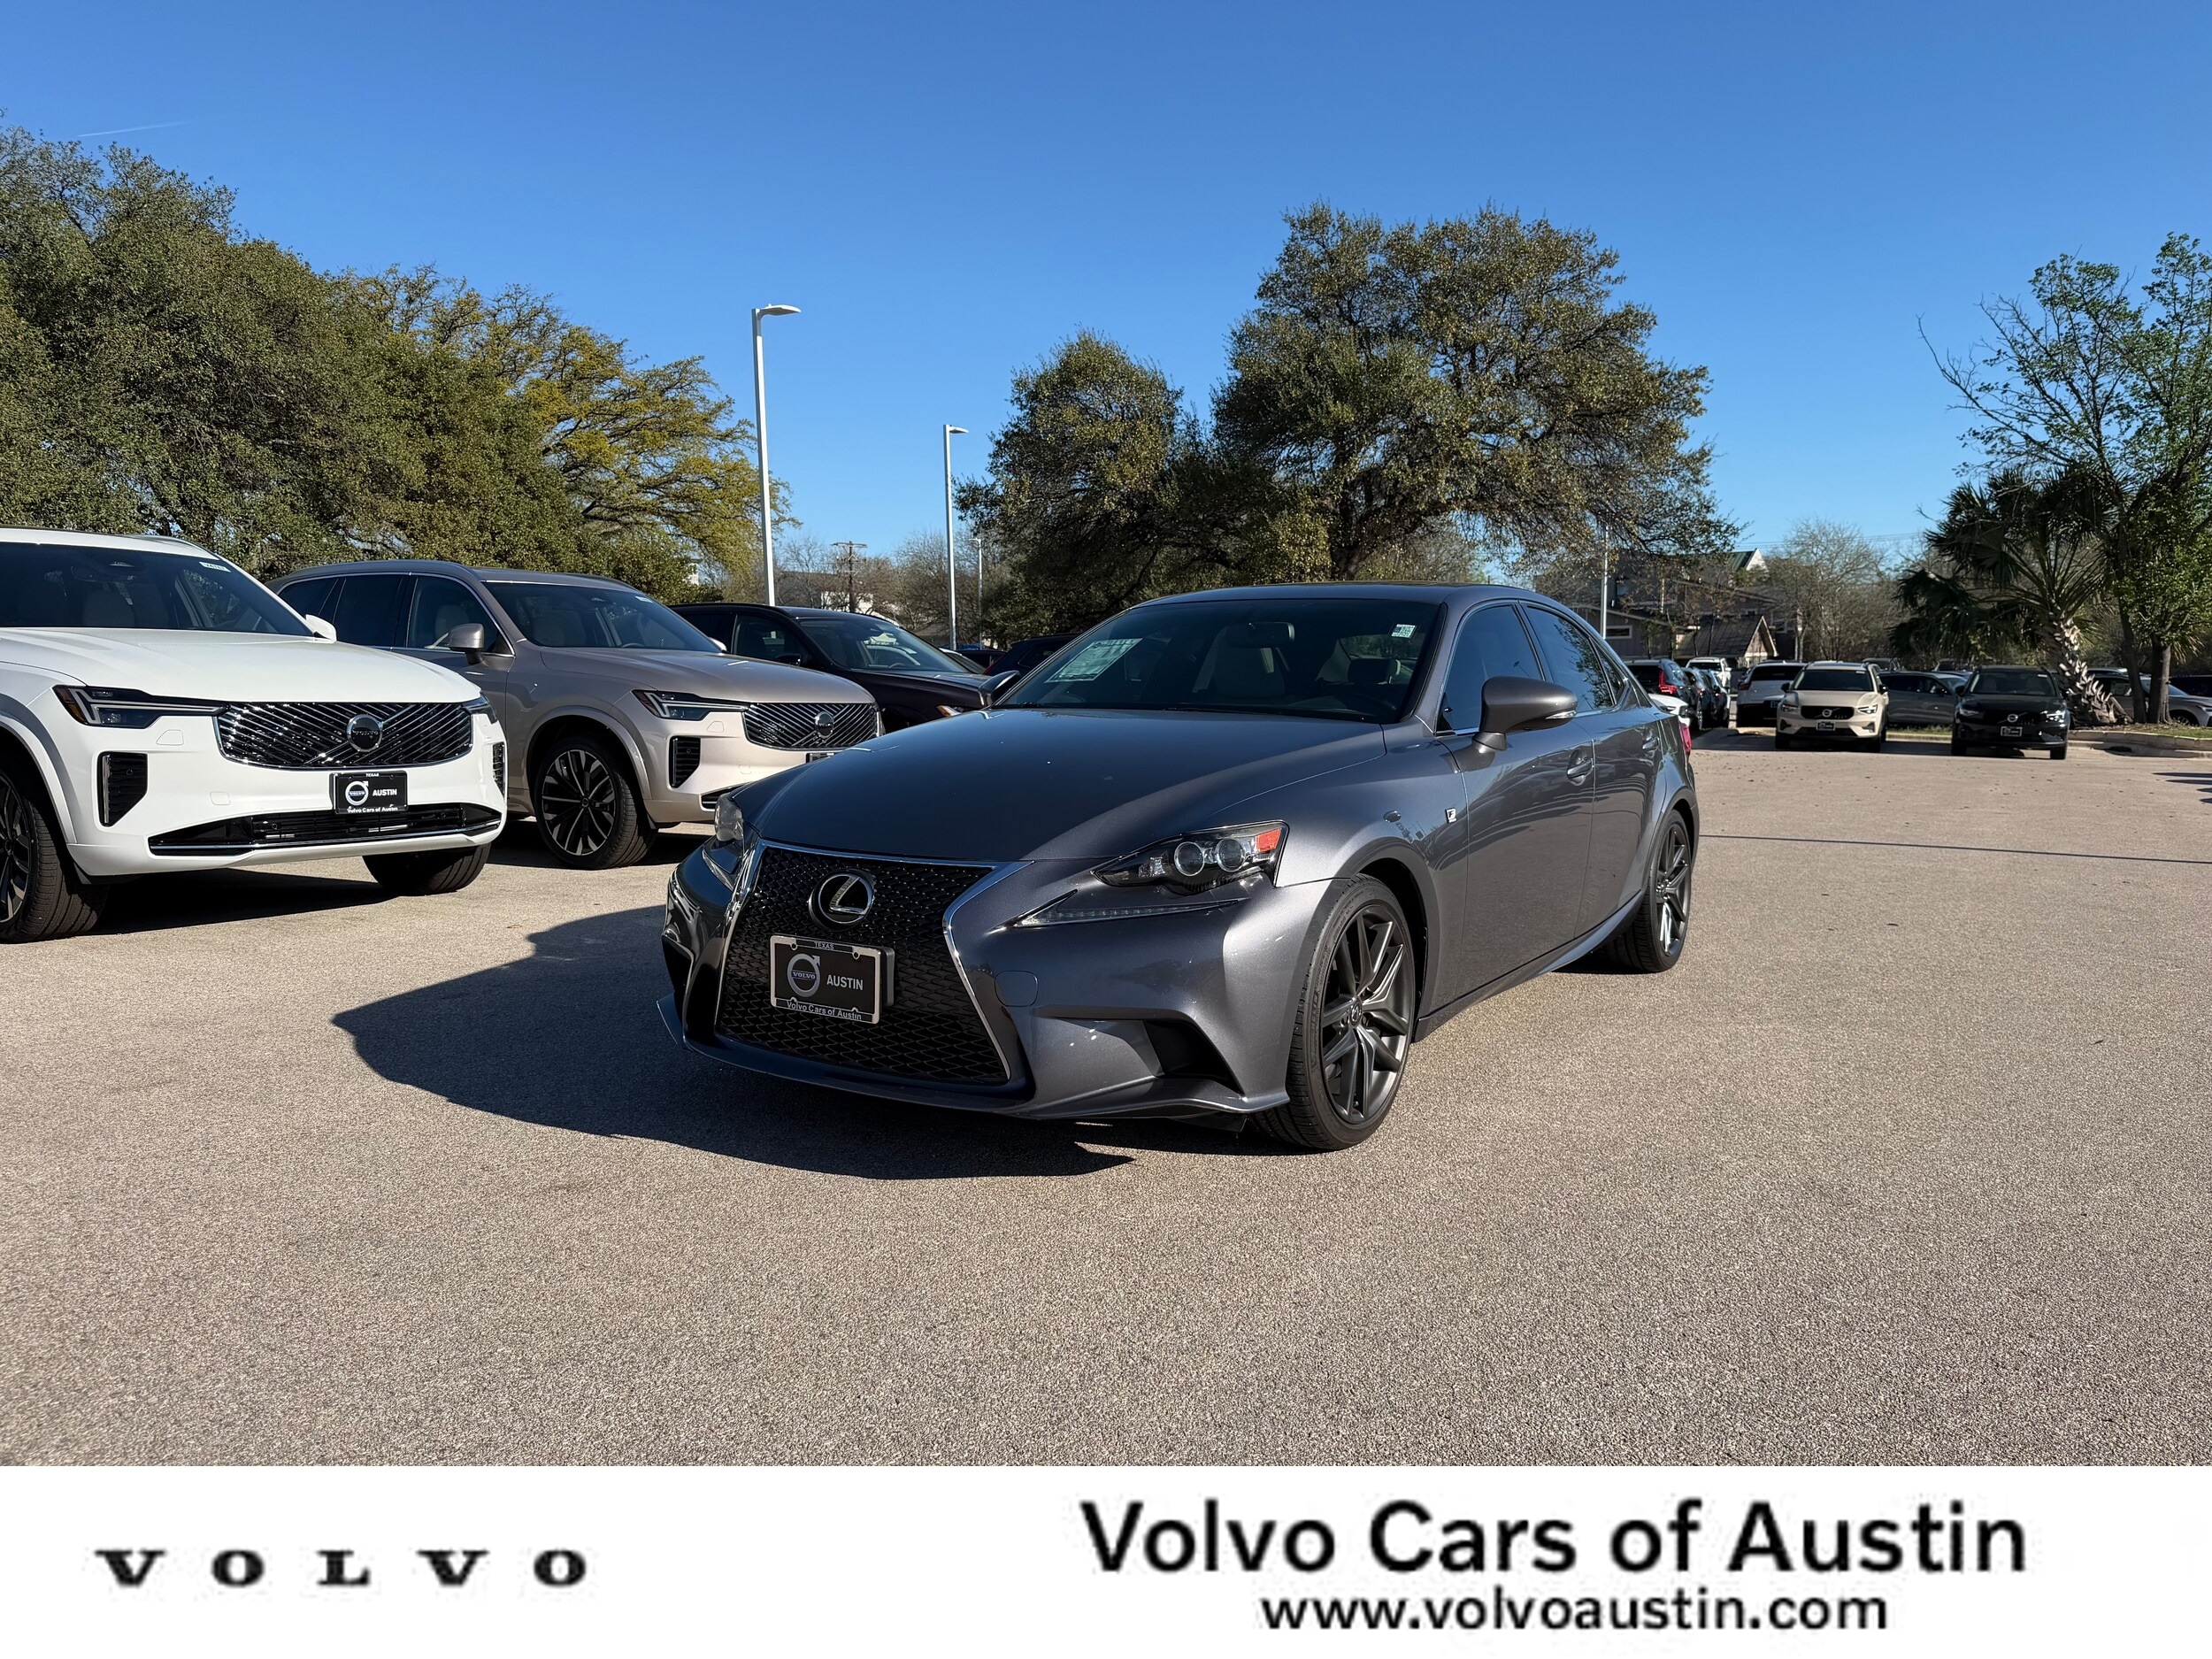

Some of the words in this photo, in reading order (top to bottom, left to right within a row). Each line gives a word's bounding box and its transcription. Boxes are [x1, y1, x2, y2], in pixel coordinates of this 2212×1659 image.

[814, 941, 834, 950] TEXAS
[826, 974, 864, 991] AUSTIN
[787, 1000, 807, 1012] Volvo
[809, 1005, 826, 1015] Cars
[837, 1010, 862, 1021] Austin
